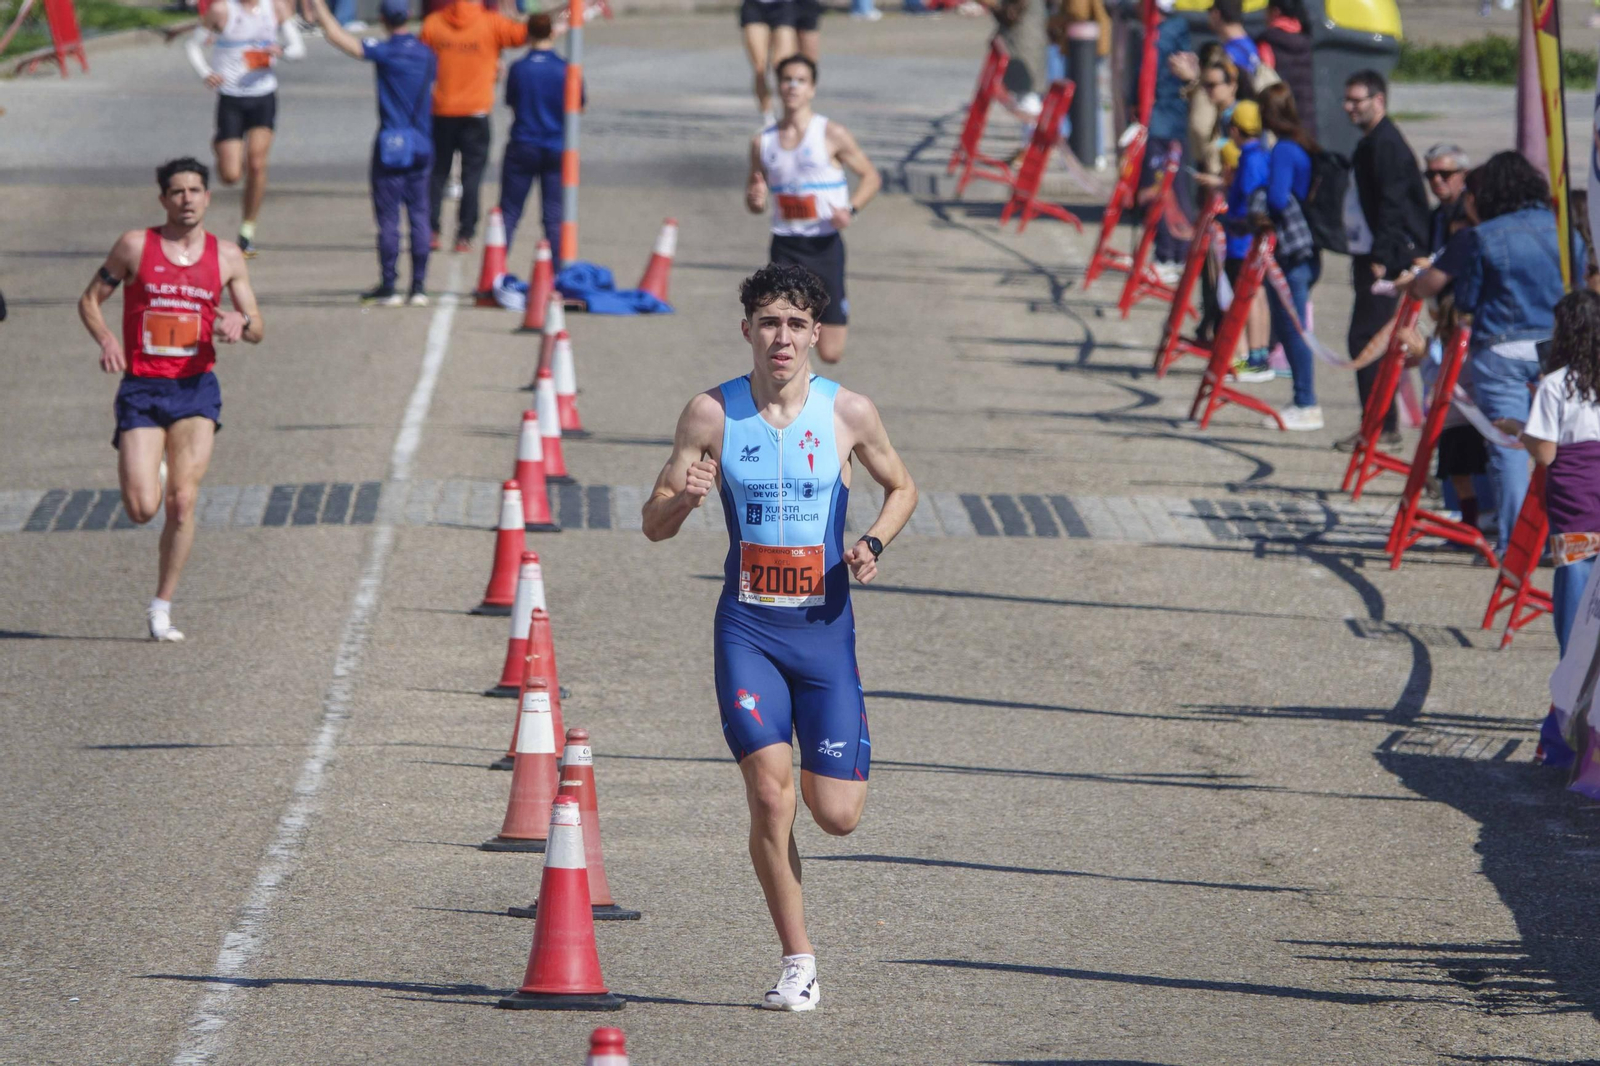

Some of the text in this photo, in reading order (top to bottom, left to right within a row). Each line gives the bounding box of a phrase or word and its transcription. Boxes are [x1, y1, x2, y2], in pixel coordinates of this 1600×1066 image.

[740, 455, 760, 463] ZICO
[748, 482, 792, 491] CONCELLO
[754, 490, 787, 498] DE VIGO
[765, 505, 800, 514] XUNTA
[765, 513, 819, 522] DE GALICIA
[752, 566, 812, 594] 2005
[818, 747, 842, 758] ZICO
